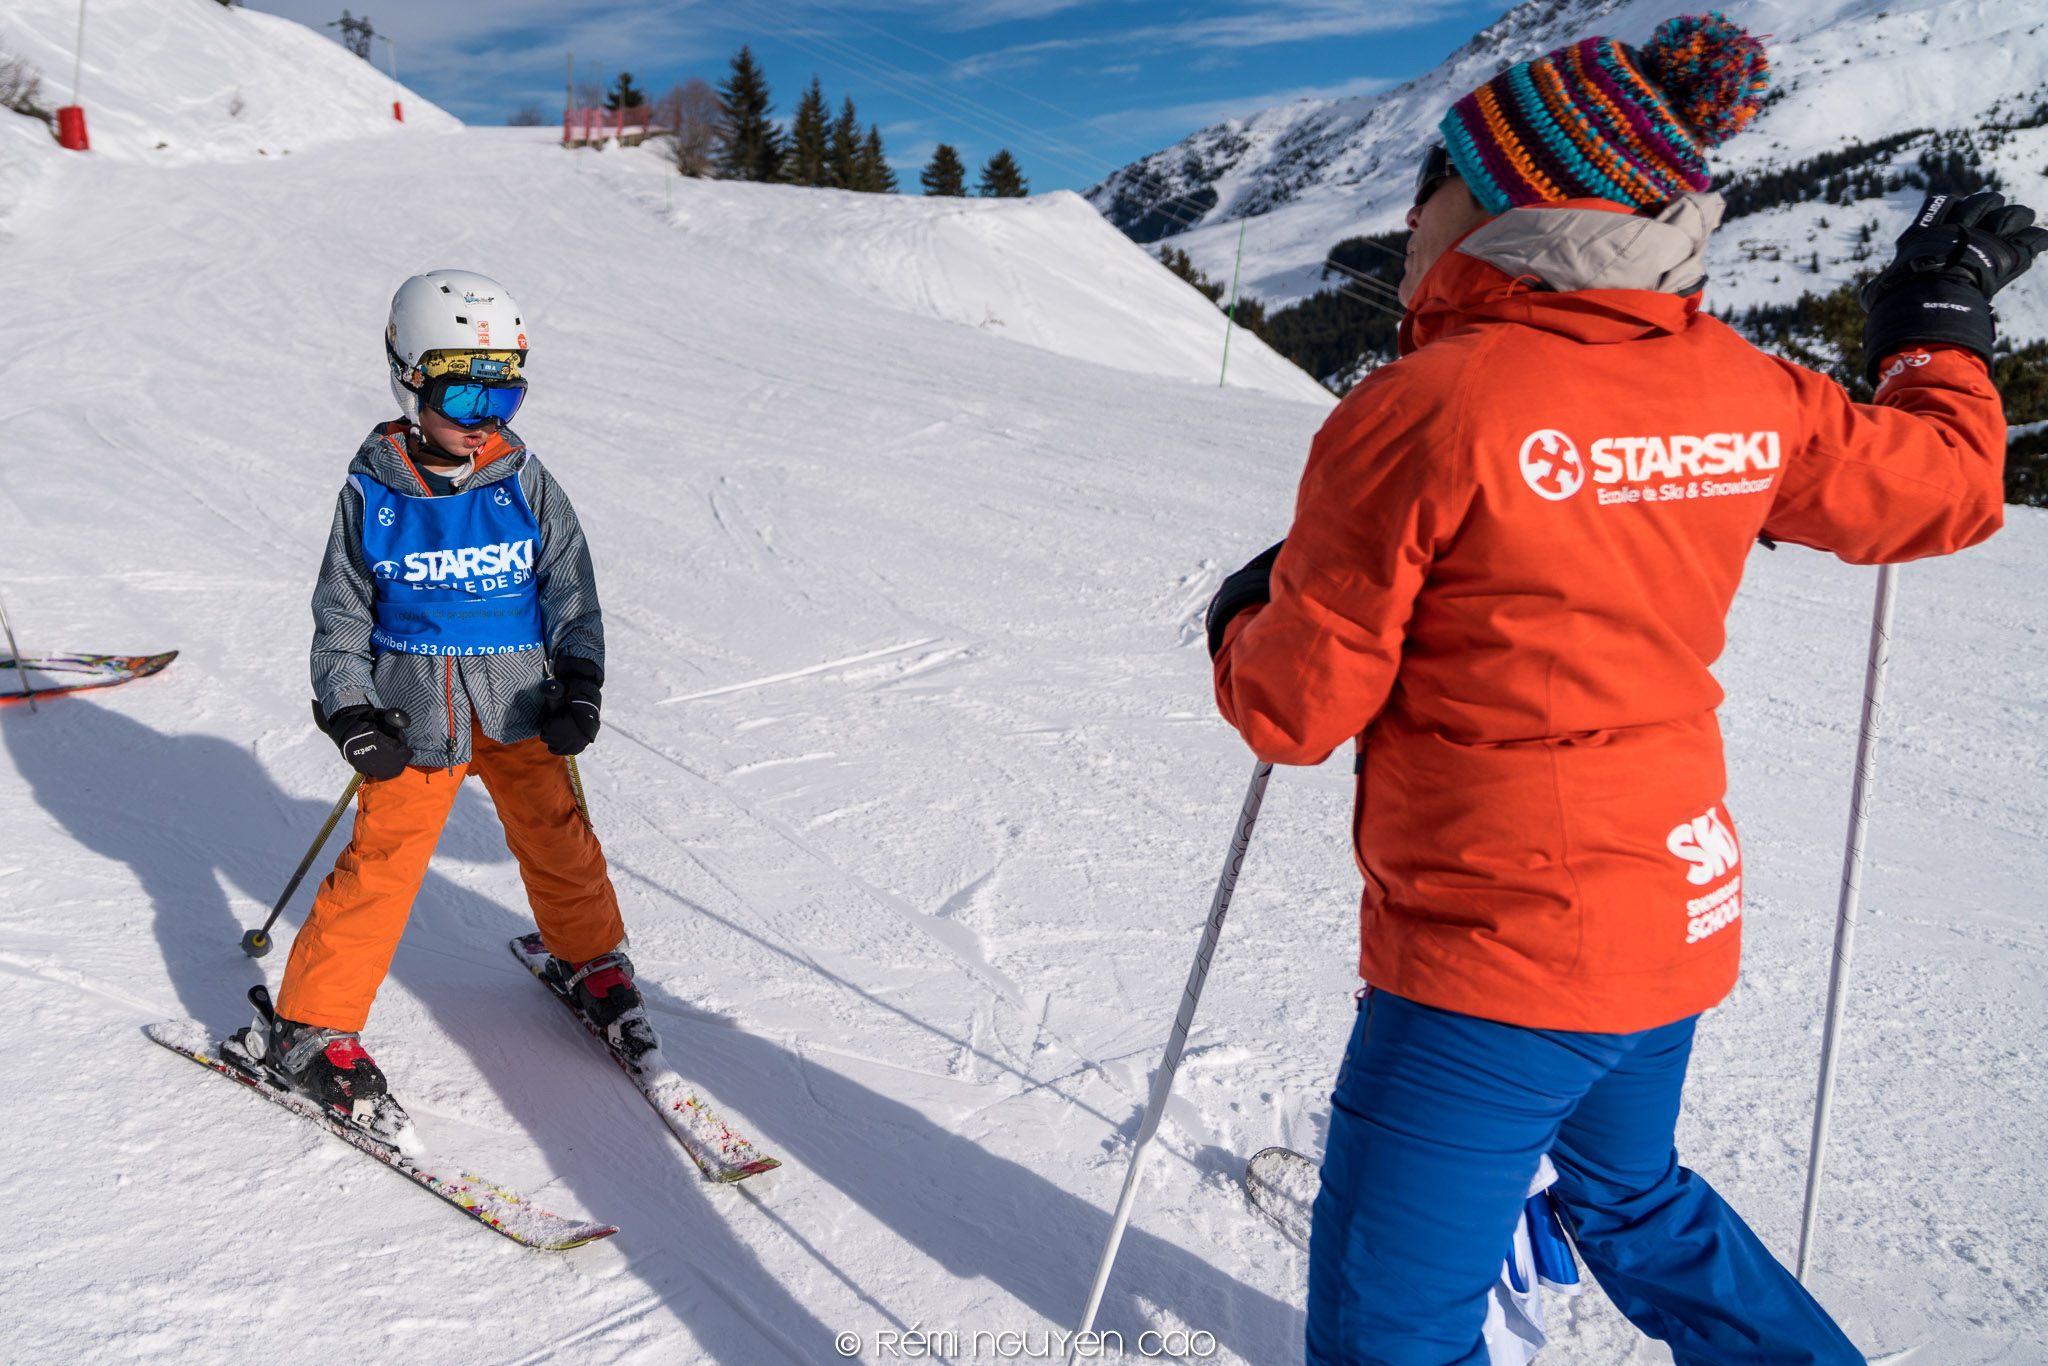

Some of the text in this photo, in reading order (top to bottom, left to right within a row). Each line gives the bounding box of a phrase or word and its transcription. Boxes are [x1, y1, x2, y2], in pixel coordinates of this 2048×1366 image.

[1590, 431, 1780, 484] STARSKI
[1658, 483, 1684, 501] Ski
[1685, 481, 1699, 499] &
[403, 538, 534, 582] STARSKI
[482, 575, 508, 592] DE
[432, 608, 444, 618] ski
[447, 608, 491, 621] properties
[493, 607, 505, 617] for
[508, 605, 523, 616] sale
[410, 643, 438, 656] +33
[441, 645, 462, 656] (0)
[464, 646, 474, 656] 4
